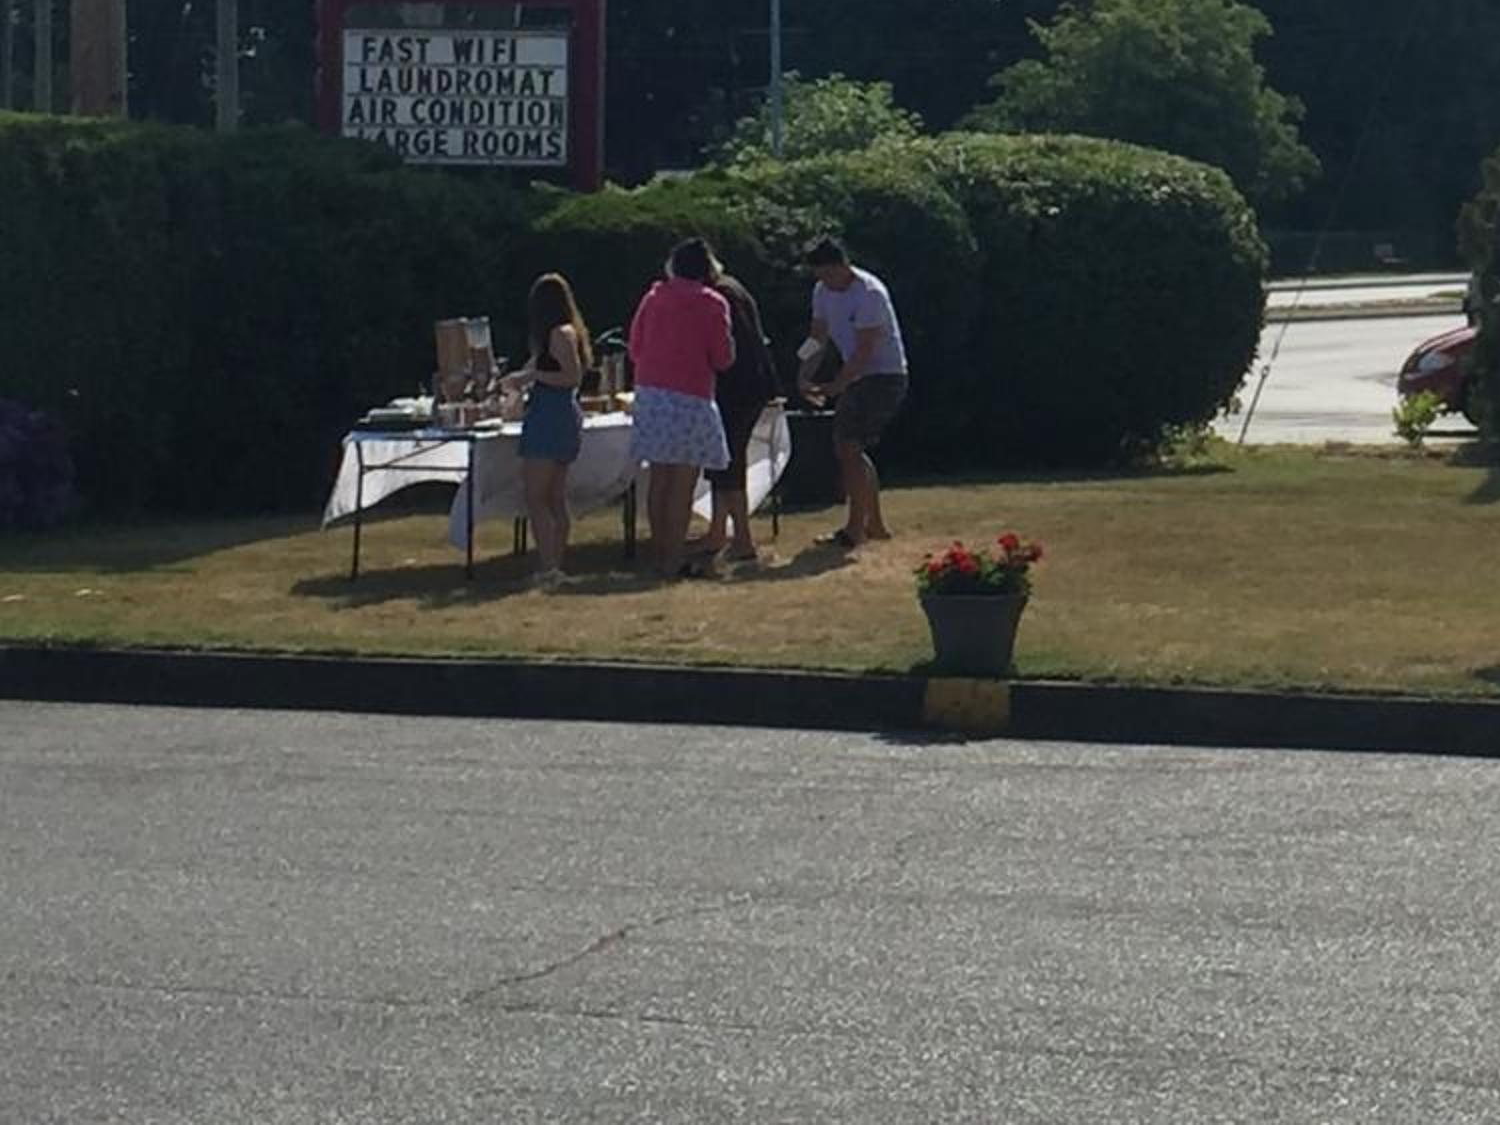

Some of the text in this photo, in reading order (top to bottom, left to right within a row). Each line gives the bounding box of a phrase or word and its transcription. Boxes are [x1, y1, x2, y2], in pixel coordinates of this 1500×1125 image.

[362, 37, 517, 63] FAST WIFI
[360, 69, 554, 96] LAUNDROMAT
[349, 98, 564, 125] AIR CONDITION
[462, 131, 562, 157] ROOMS
